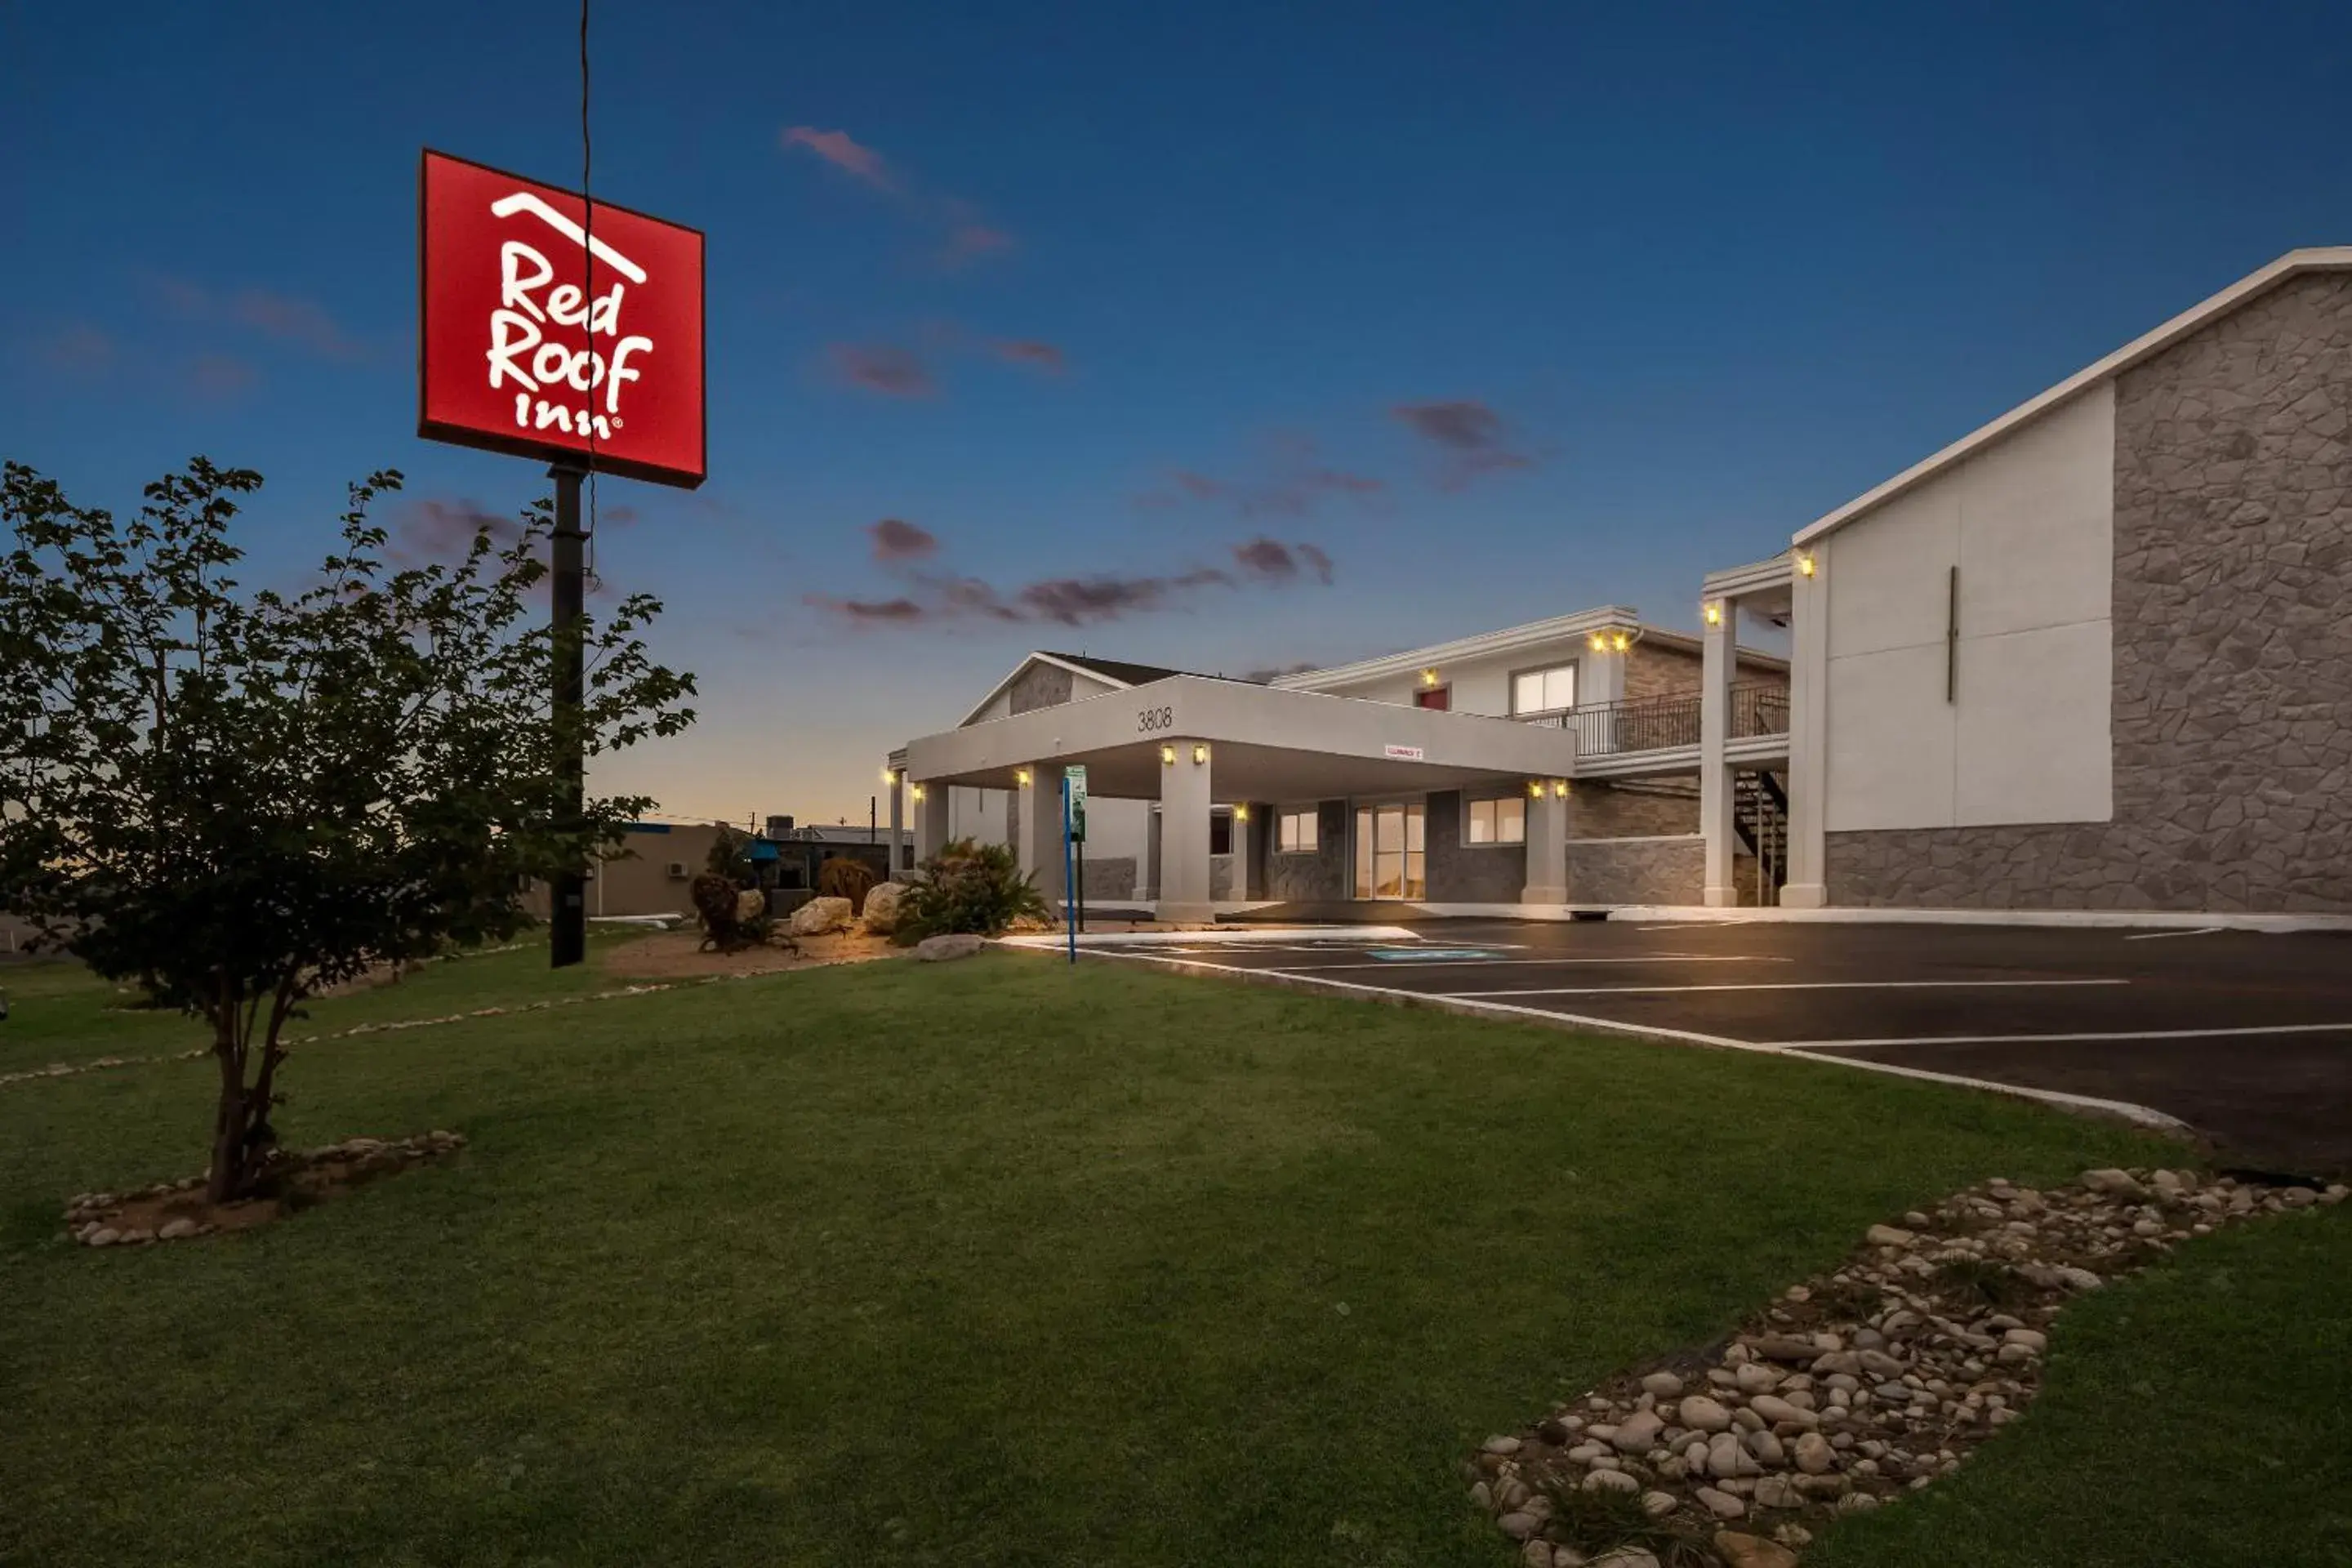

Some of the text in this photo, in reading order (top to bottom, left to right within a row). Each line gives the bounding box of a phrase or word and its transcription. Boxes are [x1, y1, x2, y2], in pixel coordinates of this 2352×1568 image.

[501, 241, 624, 336] Red
[486, 310, 653, 413] Roof
[1138, 706, 1172, 732] 3808
